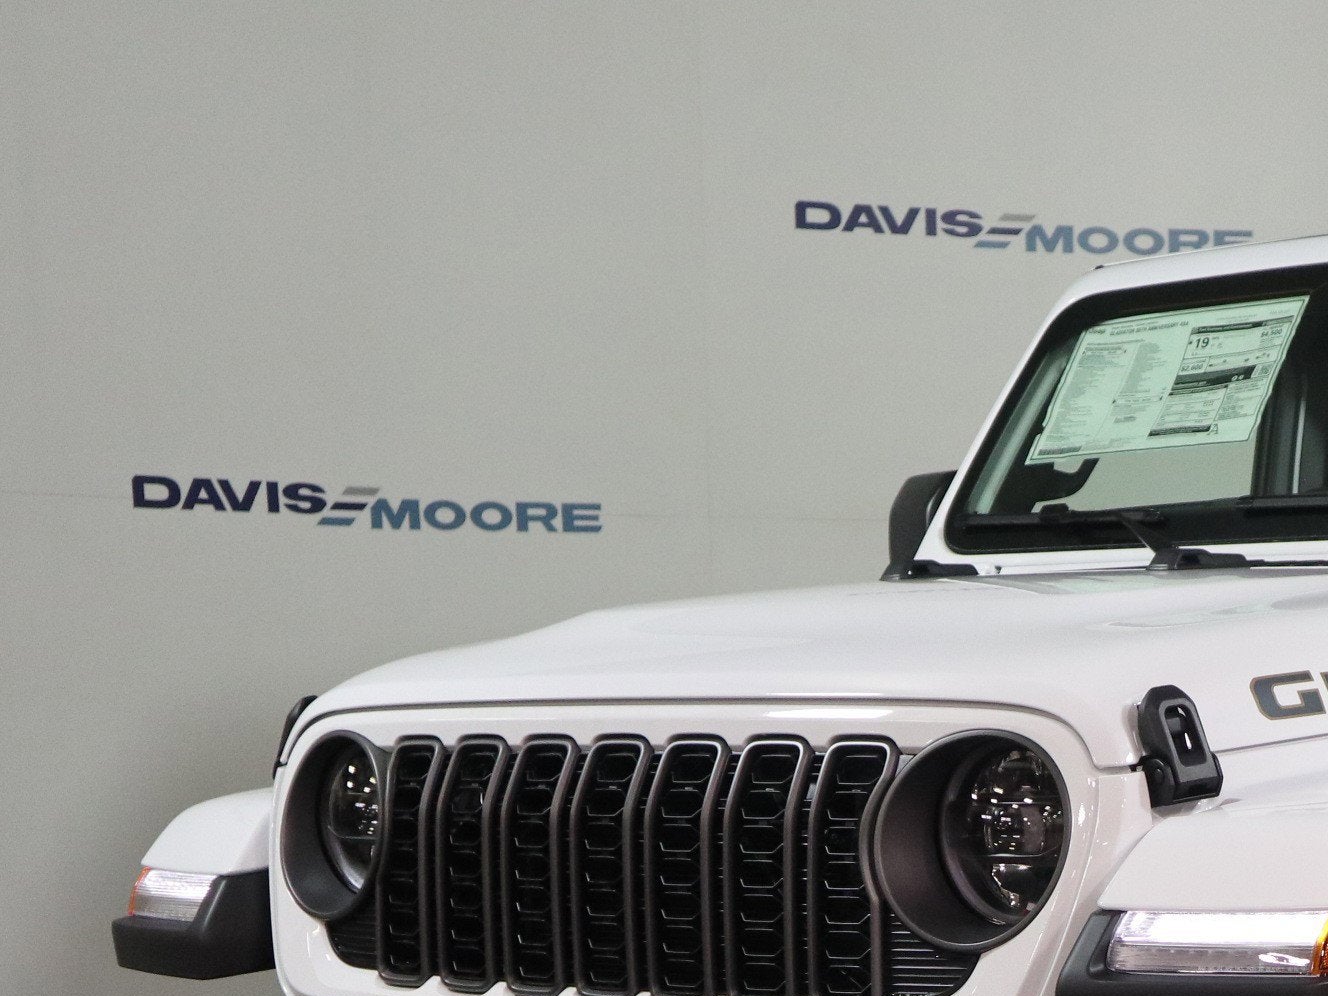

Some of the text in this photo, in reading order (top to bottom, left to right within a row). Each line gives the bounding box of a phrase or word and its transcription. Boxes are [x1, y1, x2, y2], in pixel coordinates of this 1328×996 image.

[794, 200, 983, 237] DAVIS
[1195, 337, 1210, 349] 19
[131, 475, 602, 533] DAVIS MOORE
